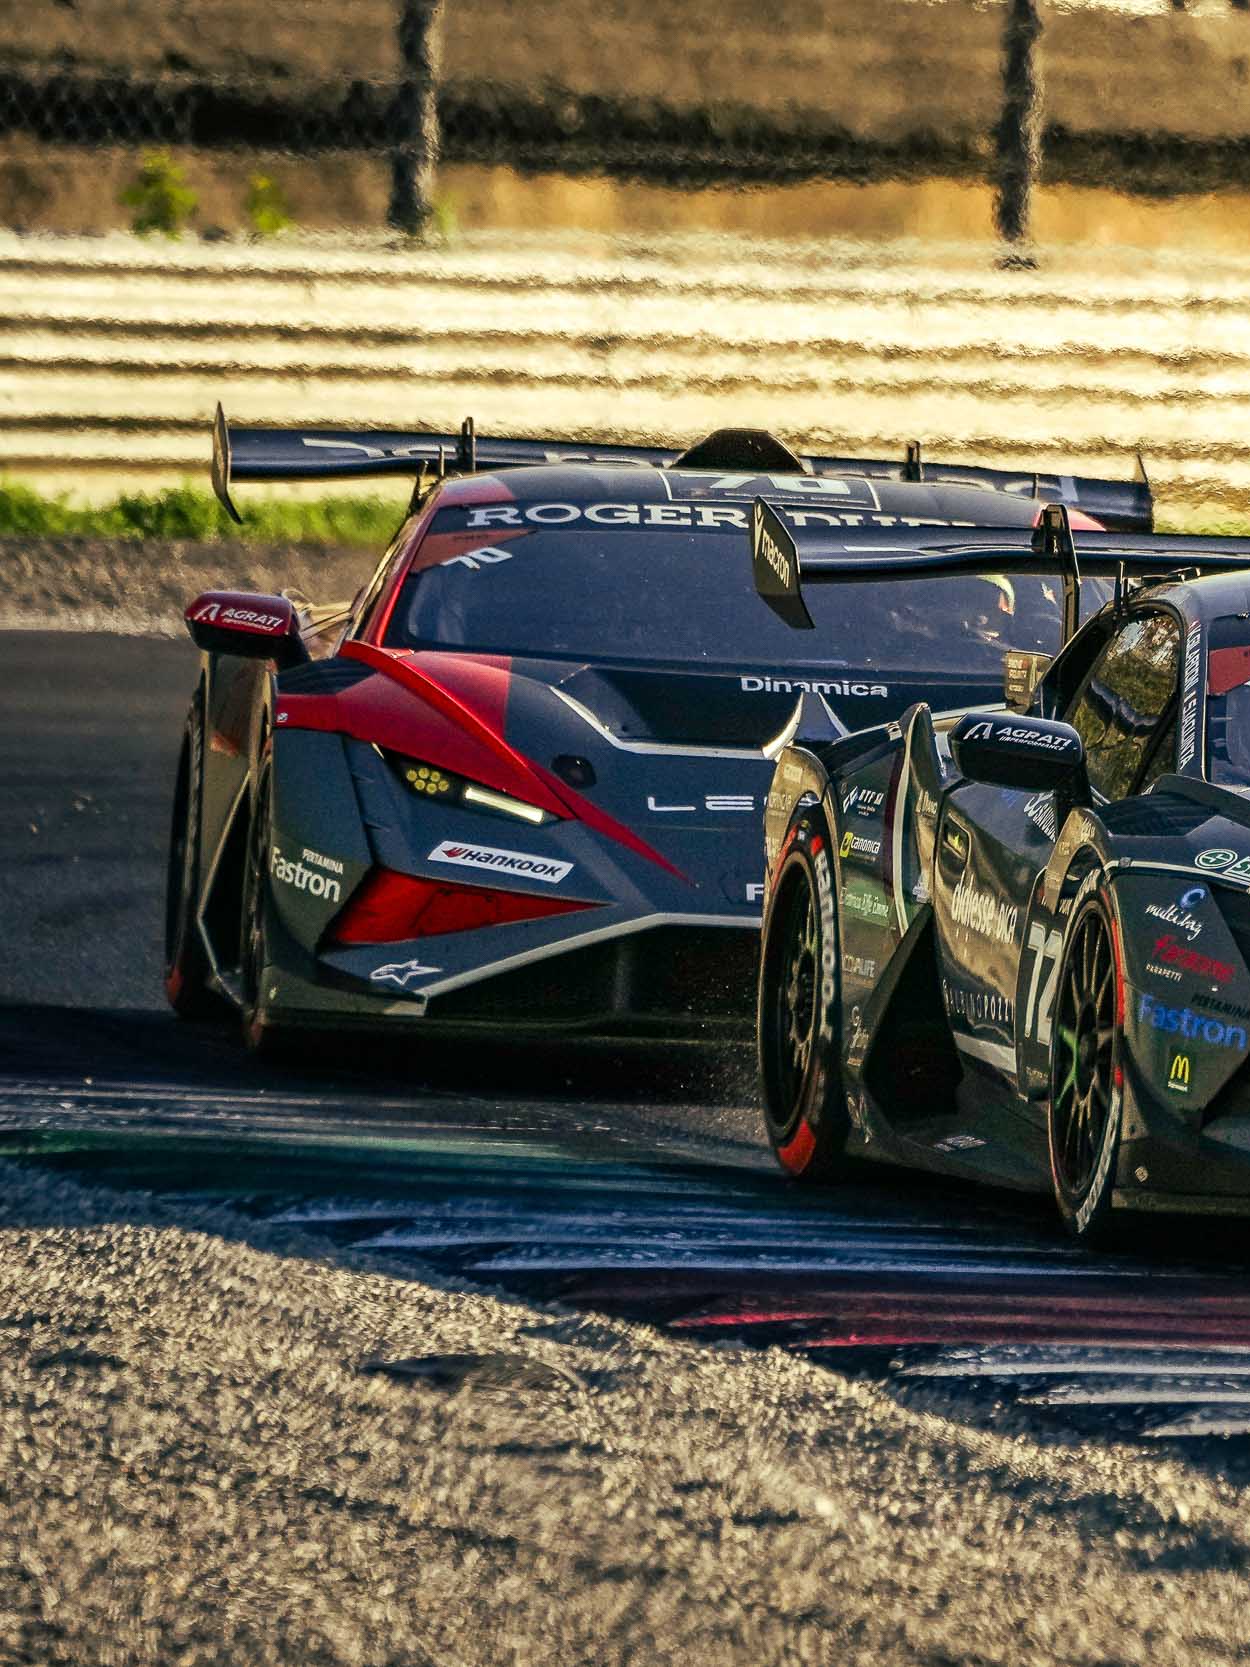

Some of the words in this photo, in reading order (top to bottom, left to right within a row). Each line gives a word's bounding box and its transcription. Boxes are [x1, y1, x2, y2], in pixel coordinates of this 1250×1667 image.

[467, 504, 750, 529] ROGER
[761, 530, 790, 589] macron
[221, 608, 284, 628] AGRATI
[741, 677, 888, 698] Dinamica
[995, 727, 1073, 746] AGRATI
[271, 846, 341, 903] Fastron
[1138, 992, 1248, 1050] Fastron
